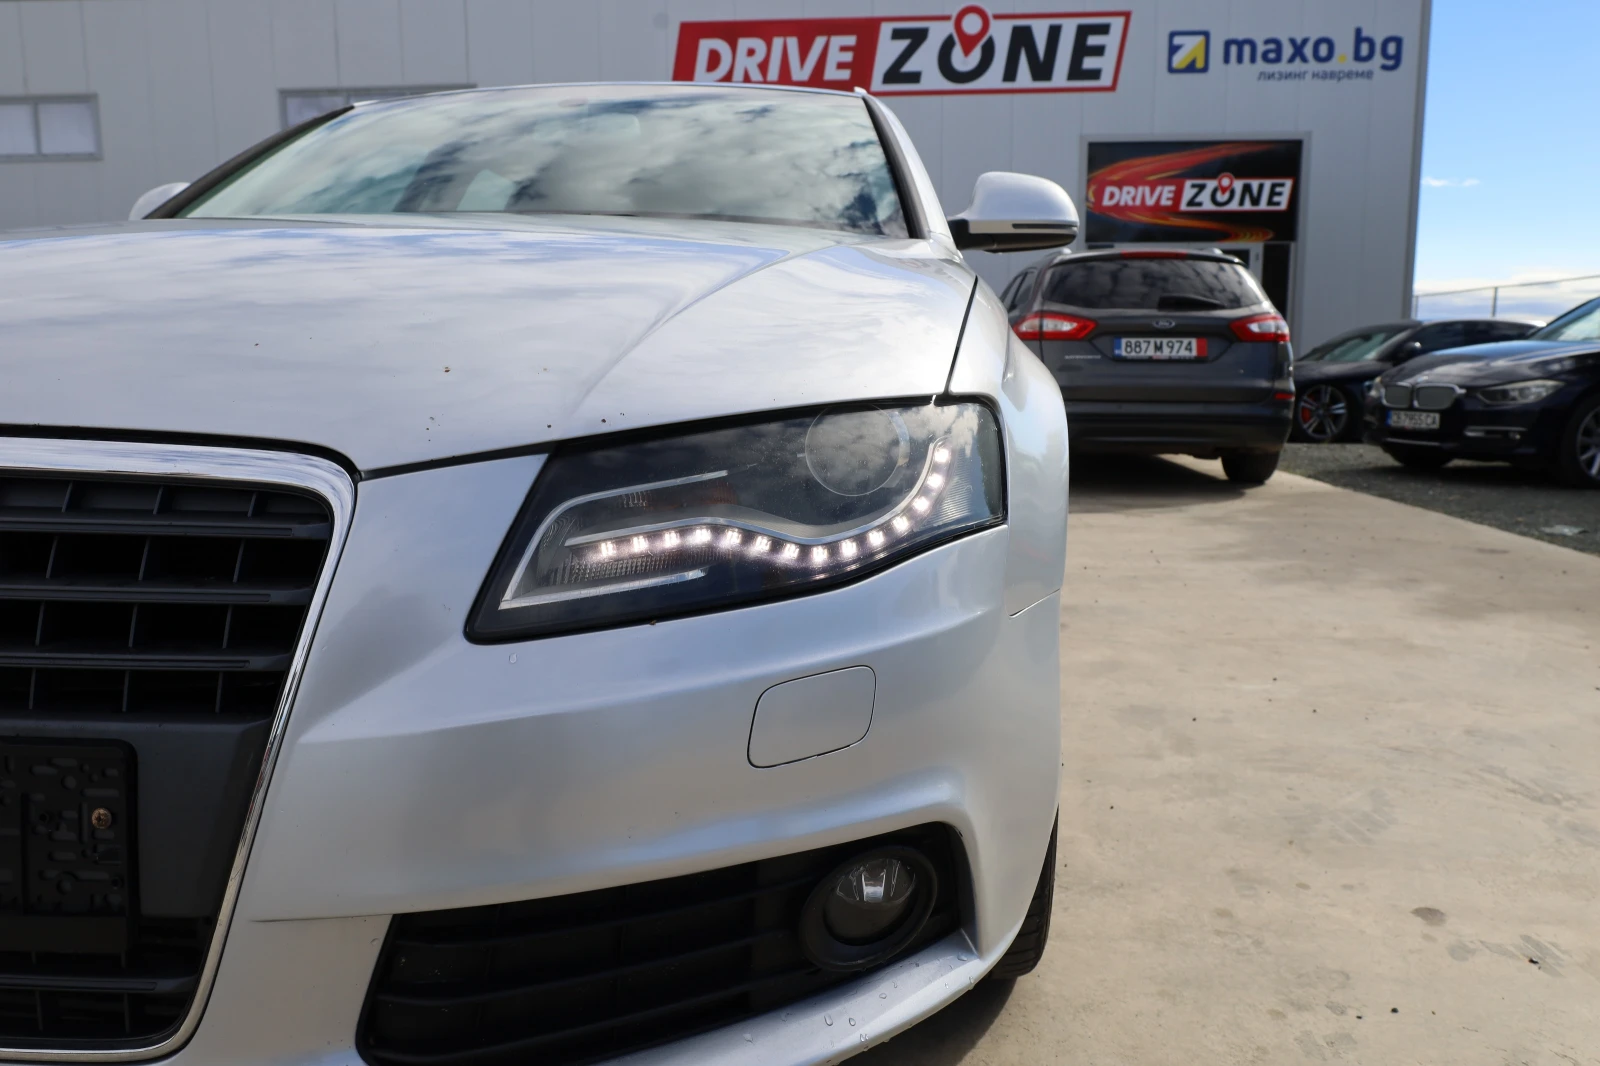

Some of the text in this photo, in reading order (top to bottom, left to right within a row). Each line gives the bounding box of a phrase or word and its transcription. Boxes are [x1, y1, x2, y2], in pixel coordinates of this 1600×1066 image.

[694, 22, 1111, 84] DRIVE ZONE
[1223, 27, 1404, 71] maxo.bg
[1257, 69, 1374, 83] лизинг навреме
[1102, 182, 1286, 208] DRIVE ZONE
[1124, 339, 1151, 355] 887
[1154, 339, 1164, 355] M
[1166, 339, 1193, 355] 974
